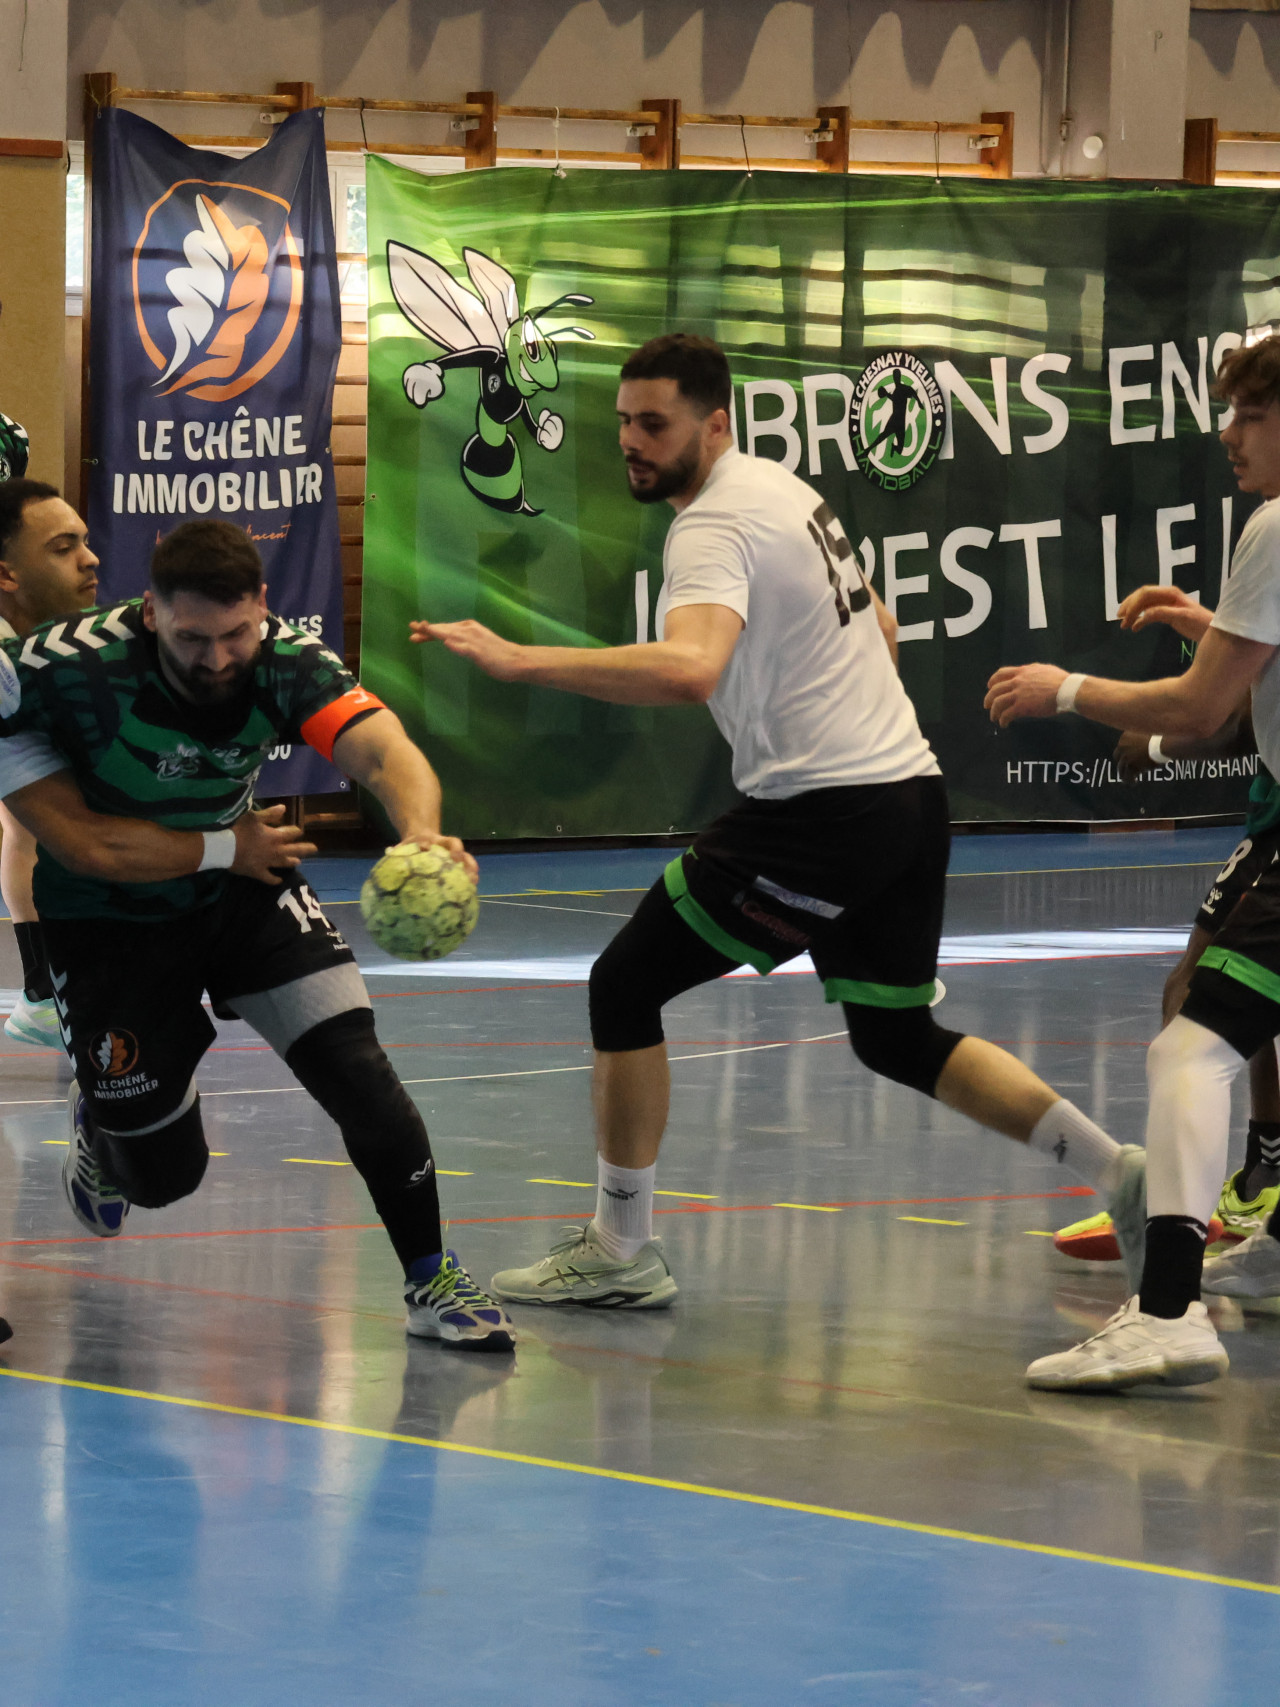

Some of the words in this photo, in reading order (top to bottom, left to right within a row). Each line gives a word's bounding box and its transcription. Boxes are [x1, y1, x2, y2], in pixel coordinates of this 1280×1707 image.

[856, 352, 902, 398] CHESNAY
[904, 353, 944, 414] YVELINES
[138, 420, 174, 461] LE
[183, 405, 307, 461] CHÊNE
[852, 431, 942, 491] HANDBALL
[94, 1079, 159, 1100] IMMOBILIER
[98, 1080, 109, 1090] LE
